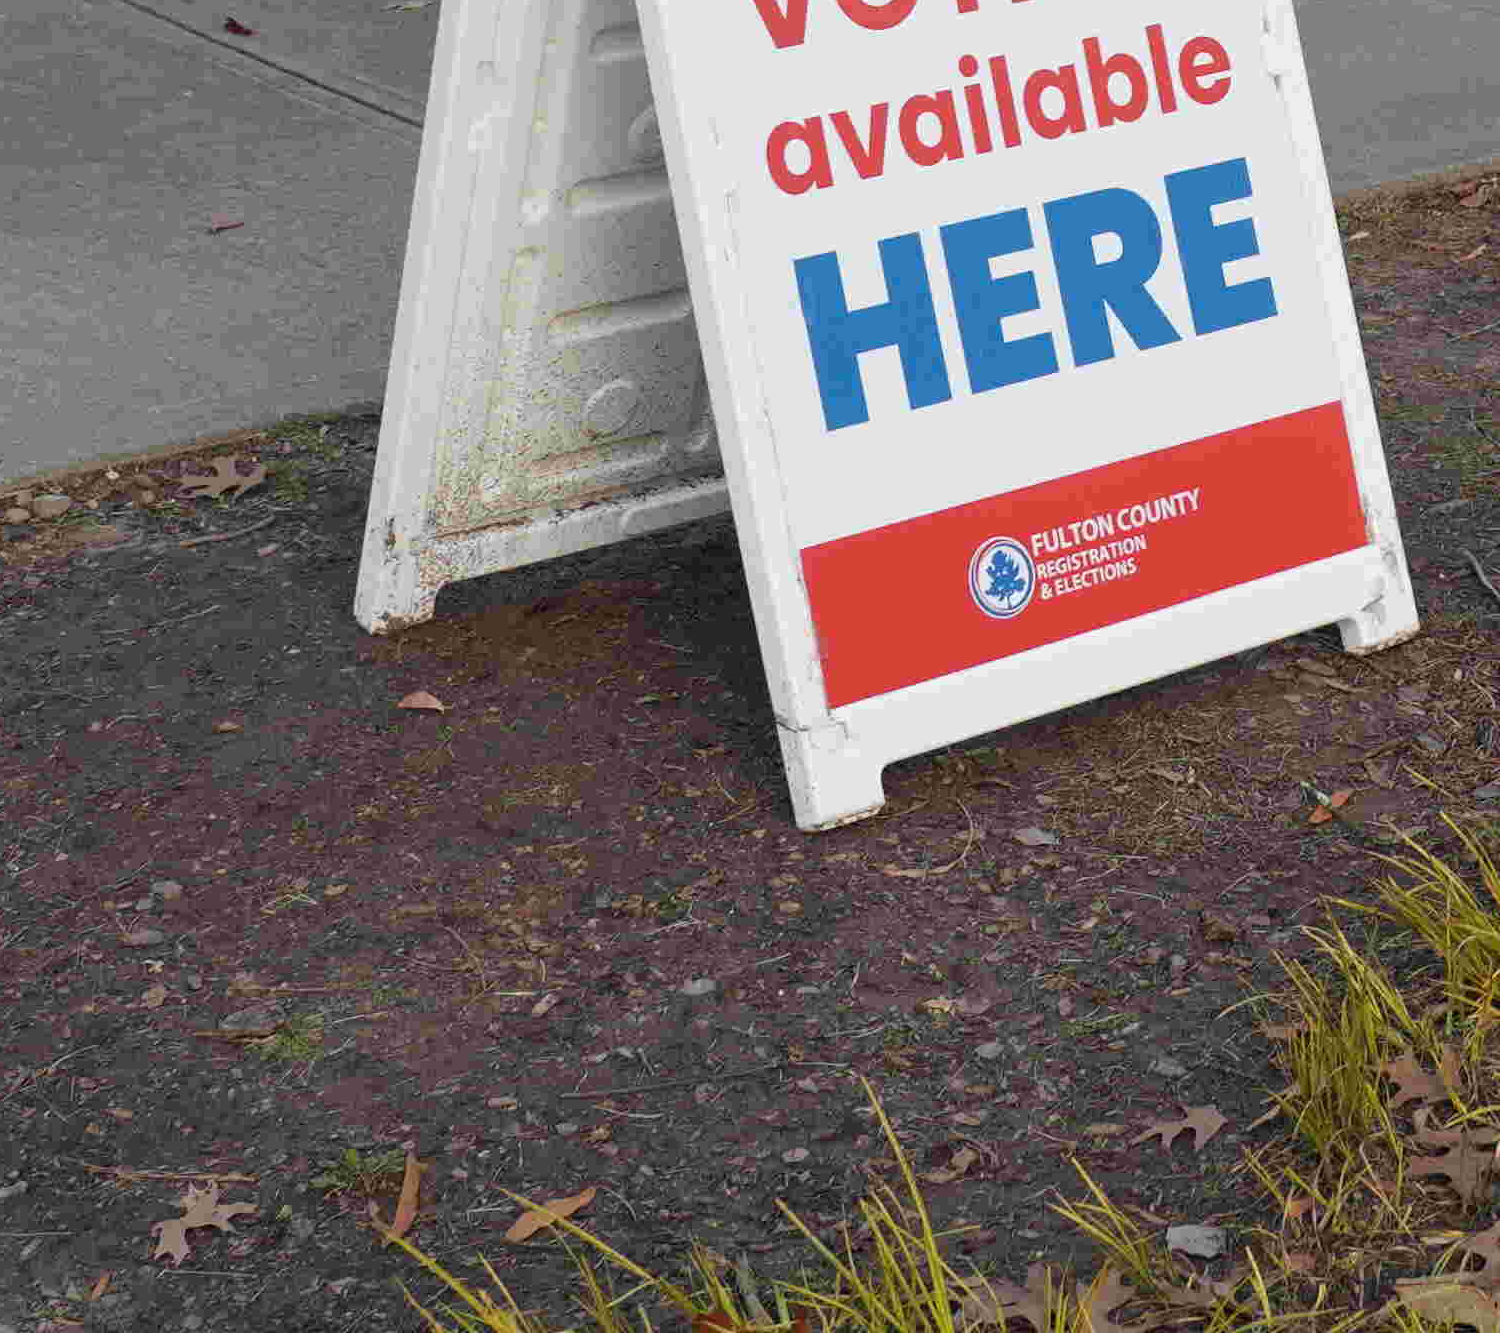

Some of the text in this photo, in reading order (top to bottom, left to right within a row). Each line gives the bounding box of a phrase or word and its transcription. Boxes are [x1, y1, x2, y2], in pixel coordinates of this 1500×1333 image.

[765, 23, 1233, 196] available
[791, 156, 1280, 432] HERE
[1030, 488, 1201, 557] FULTON COUNTY
[1036, 534, 1149, 580] REGISTRATION
[1040, 557, 1138, 600] & ELECTIONS
